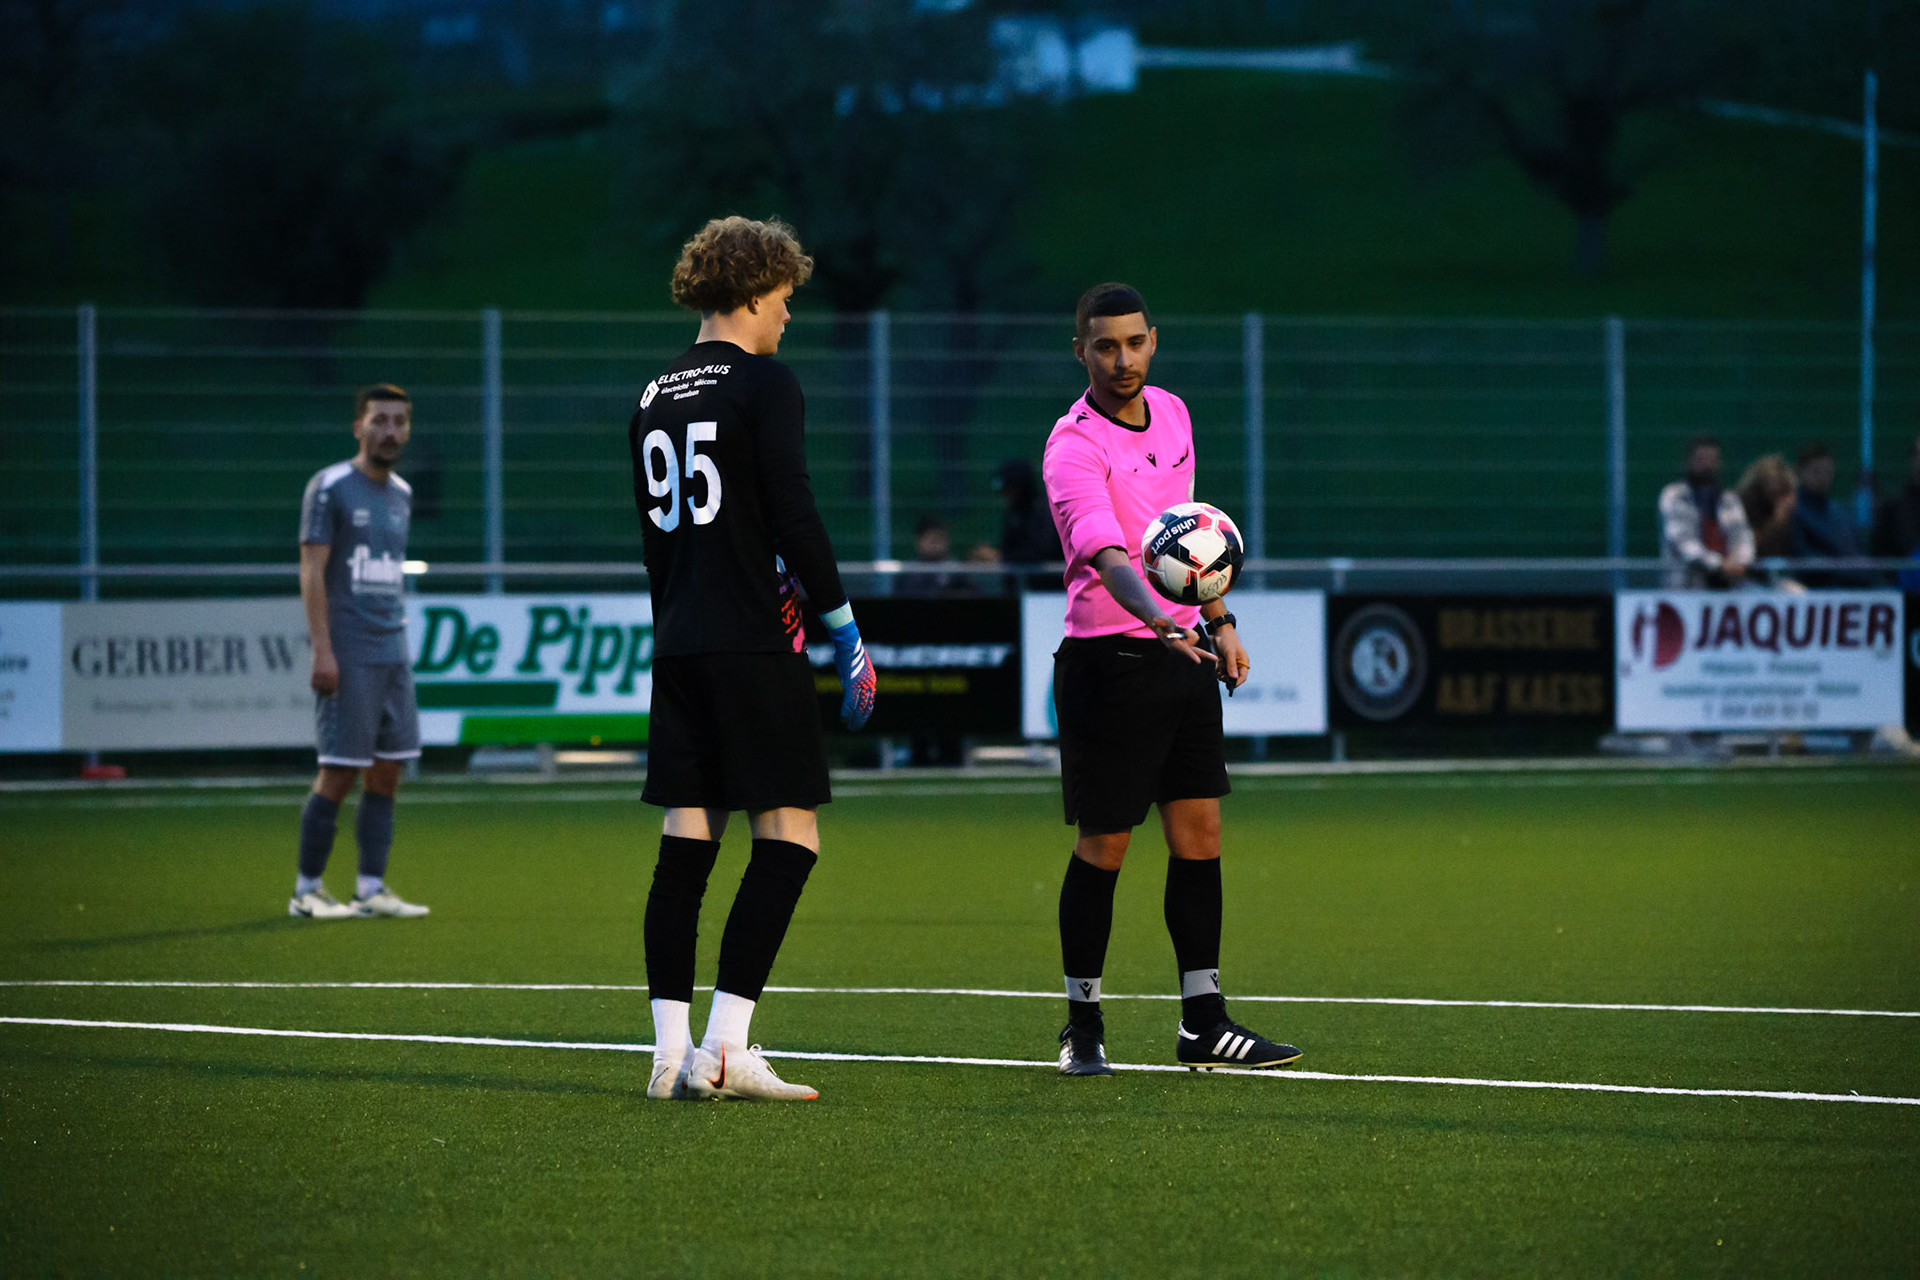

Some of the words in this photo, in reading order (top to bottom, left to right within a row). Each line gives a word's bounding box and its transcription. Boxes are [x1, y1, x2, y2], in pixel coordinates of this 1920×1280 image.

[657, 364, 732, 386] ELECTRO-PLUS
[643, 421, 722, 533] 95
[412, 606, 499, 674] De
[1437, 608, 1599, 648] BRASSERIE
[1696, 603, 1896, 654] JAQUIER
[71, 634, 249, 678] GERBER
